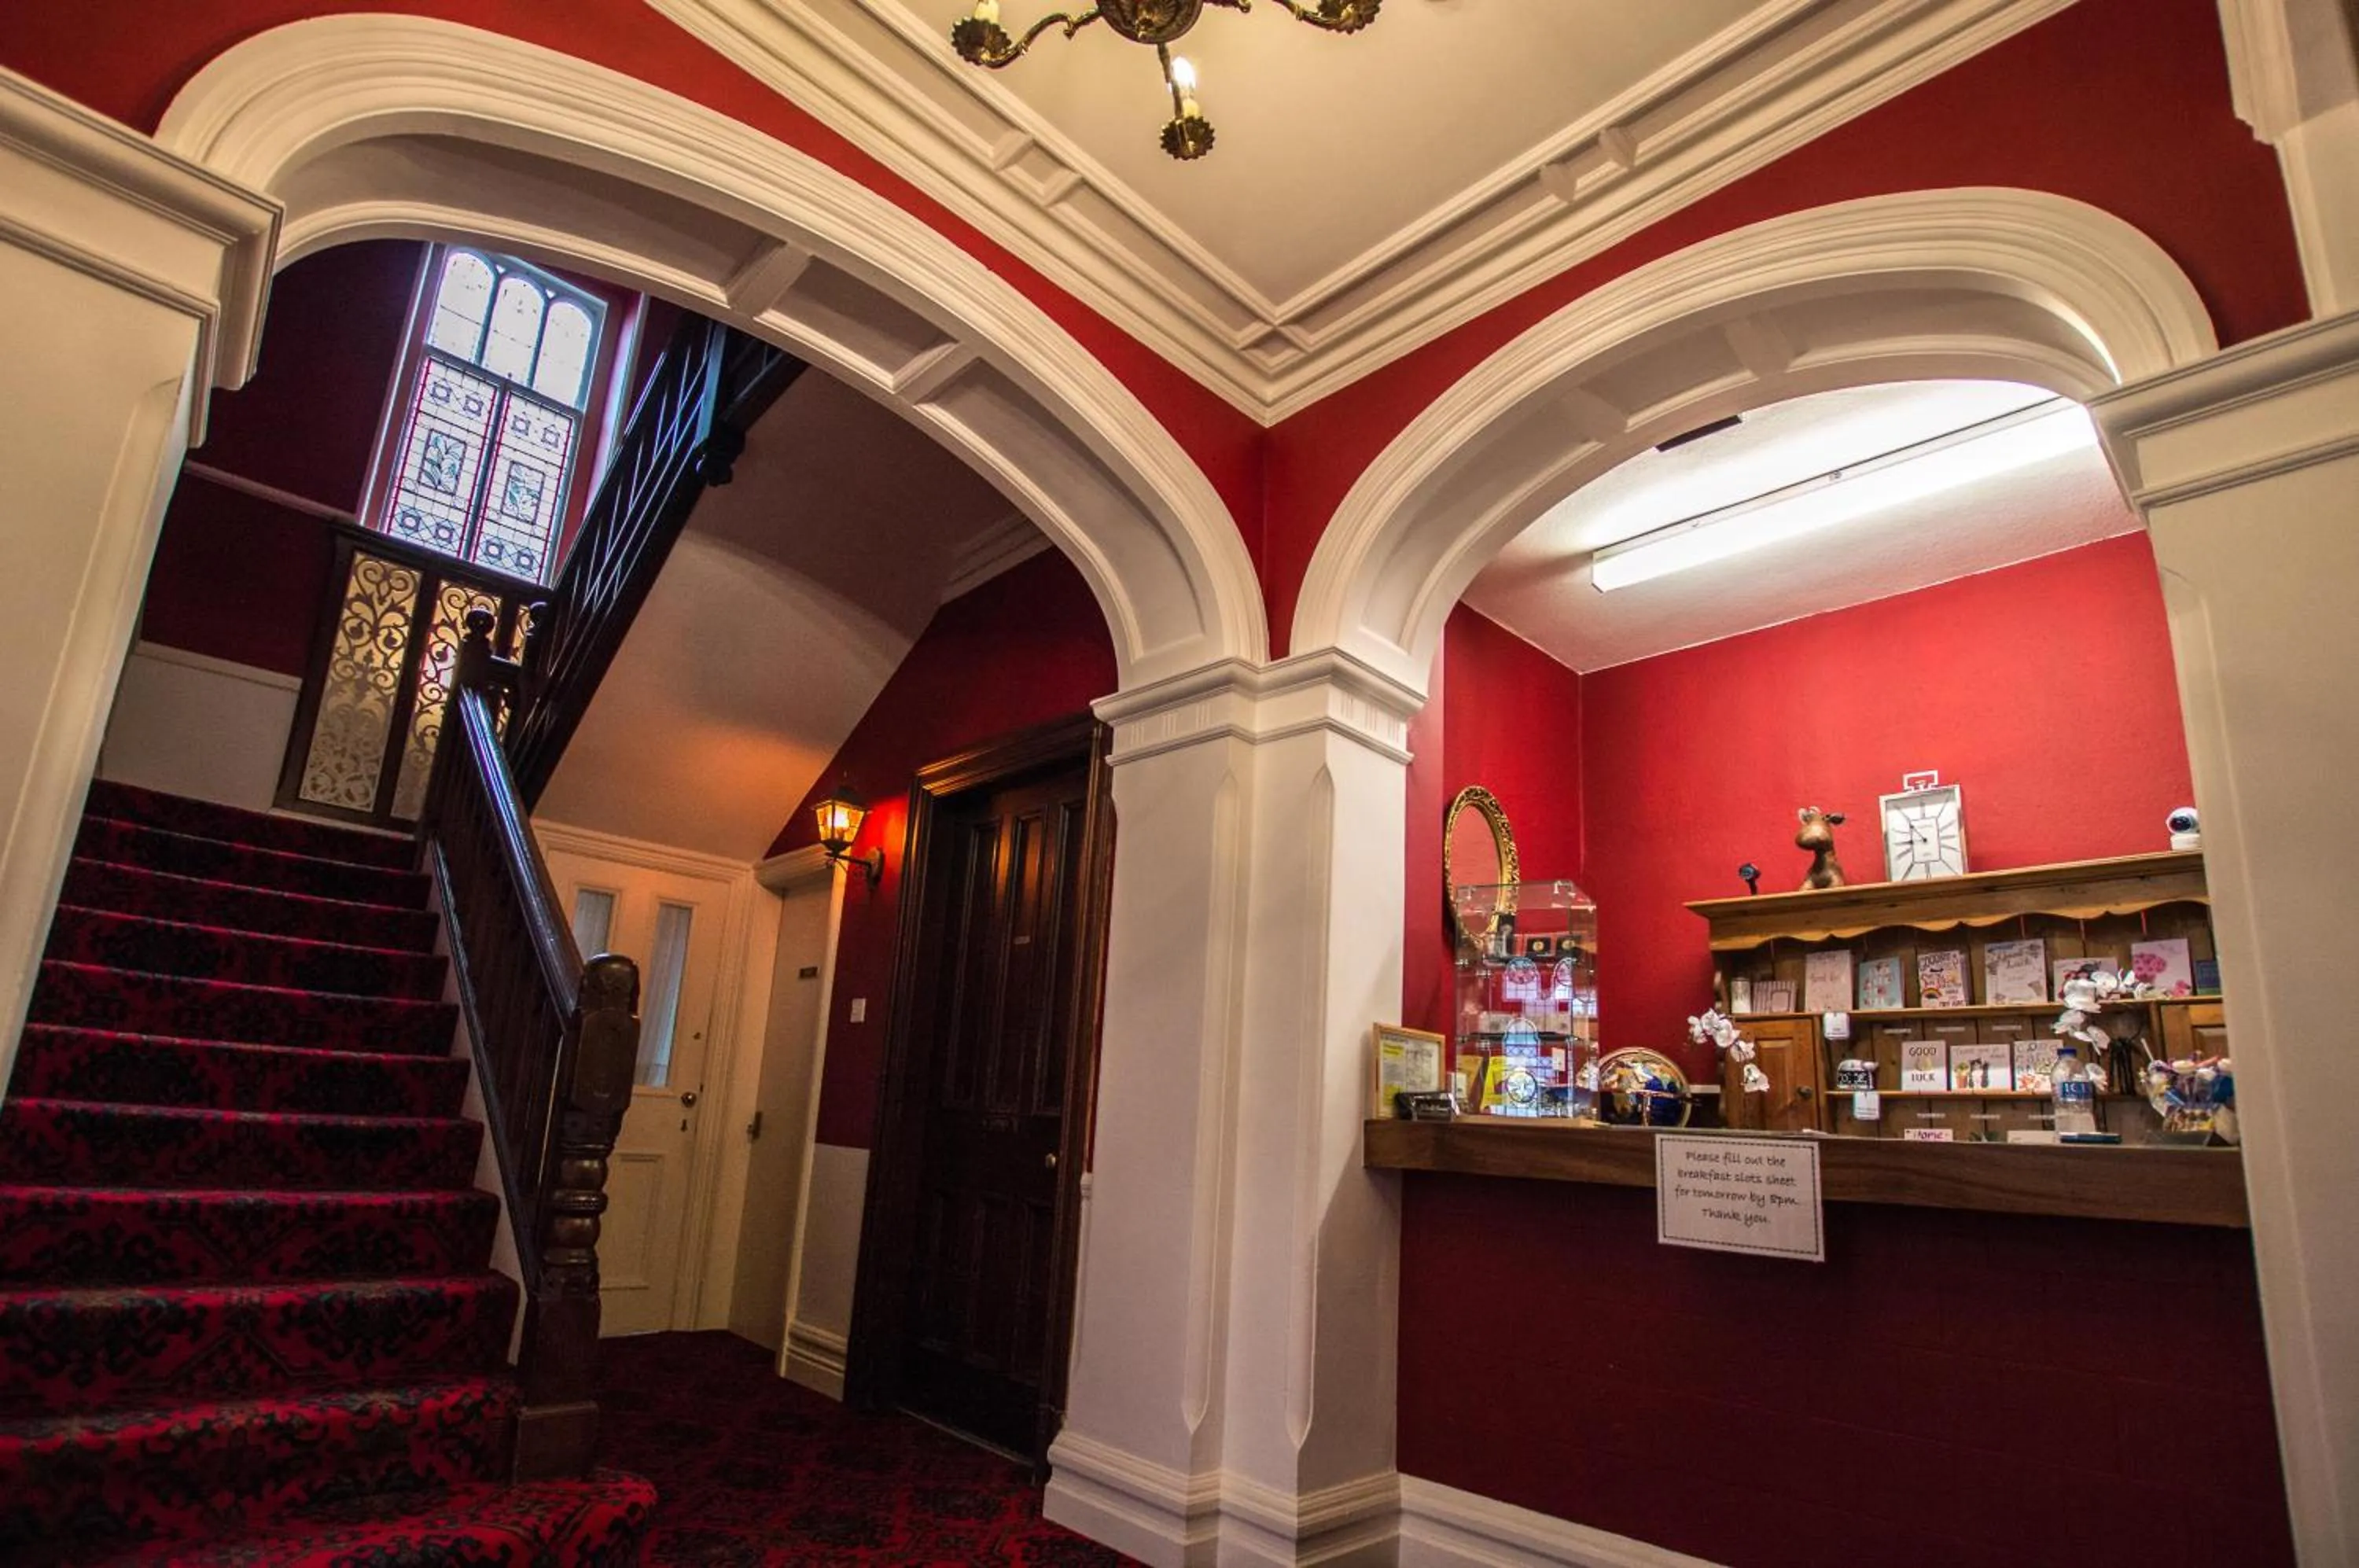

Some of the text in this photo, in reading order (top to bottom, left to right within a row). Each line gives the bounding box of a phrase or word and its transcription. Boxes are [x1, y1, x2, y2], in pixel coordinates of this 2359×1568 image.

[1908, 1047, 1937, 1056] GOOD
[1686, 1151, 1719, 1163] Please
[1723, 1151, 1741, 1166] fill
[1767, 1156, 1786, 1167] the
[1677, 1169, 1797, 1187] breakfast slots sheet
[1675, 1184, 1690, 1199] for
[1692, 1190, 1746, 1201] tomorrow
[1750, 1191, 1765, 1209] by
[1702, 1208, 1741, 1222] Thank
